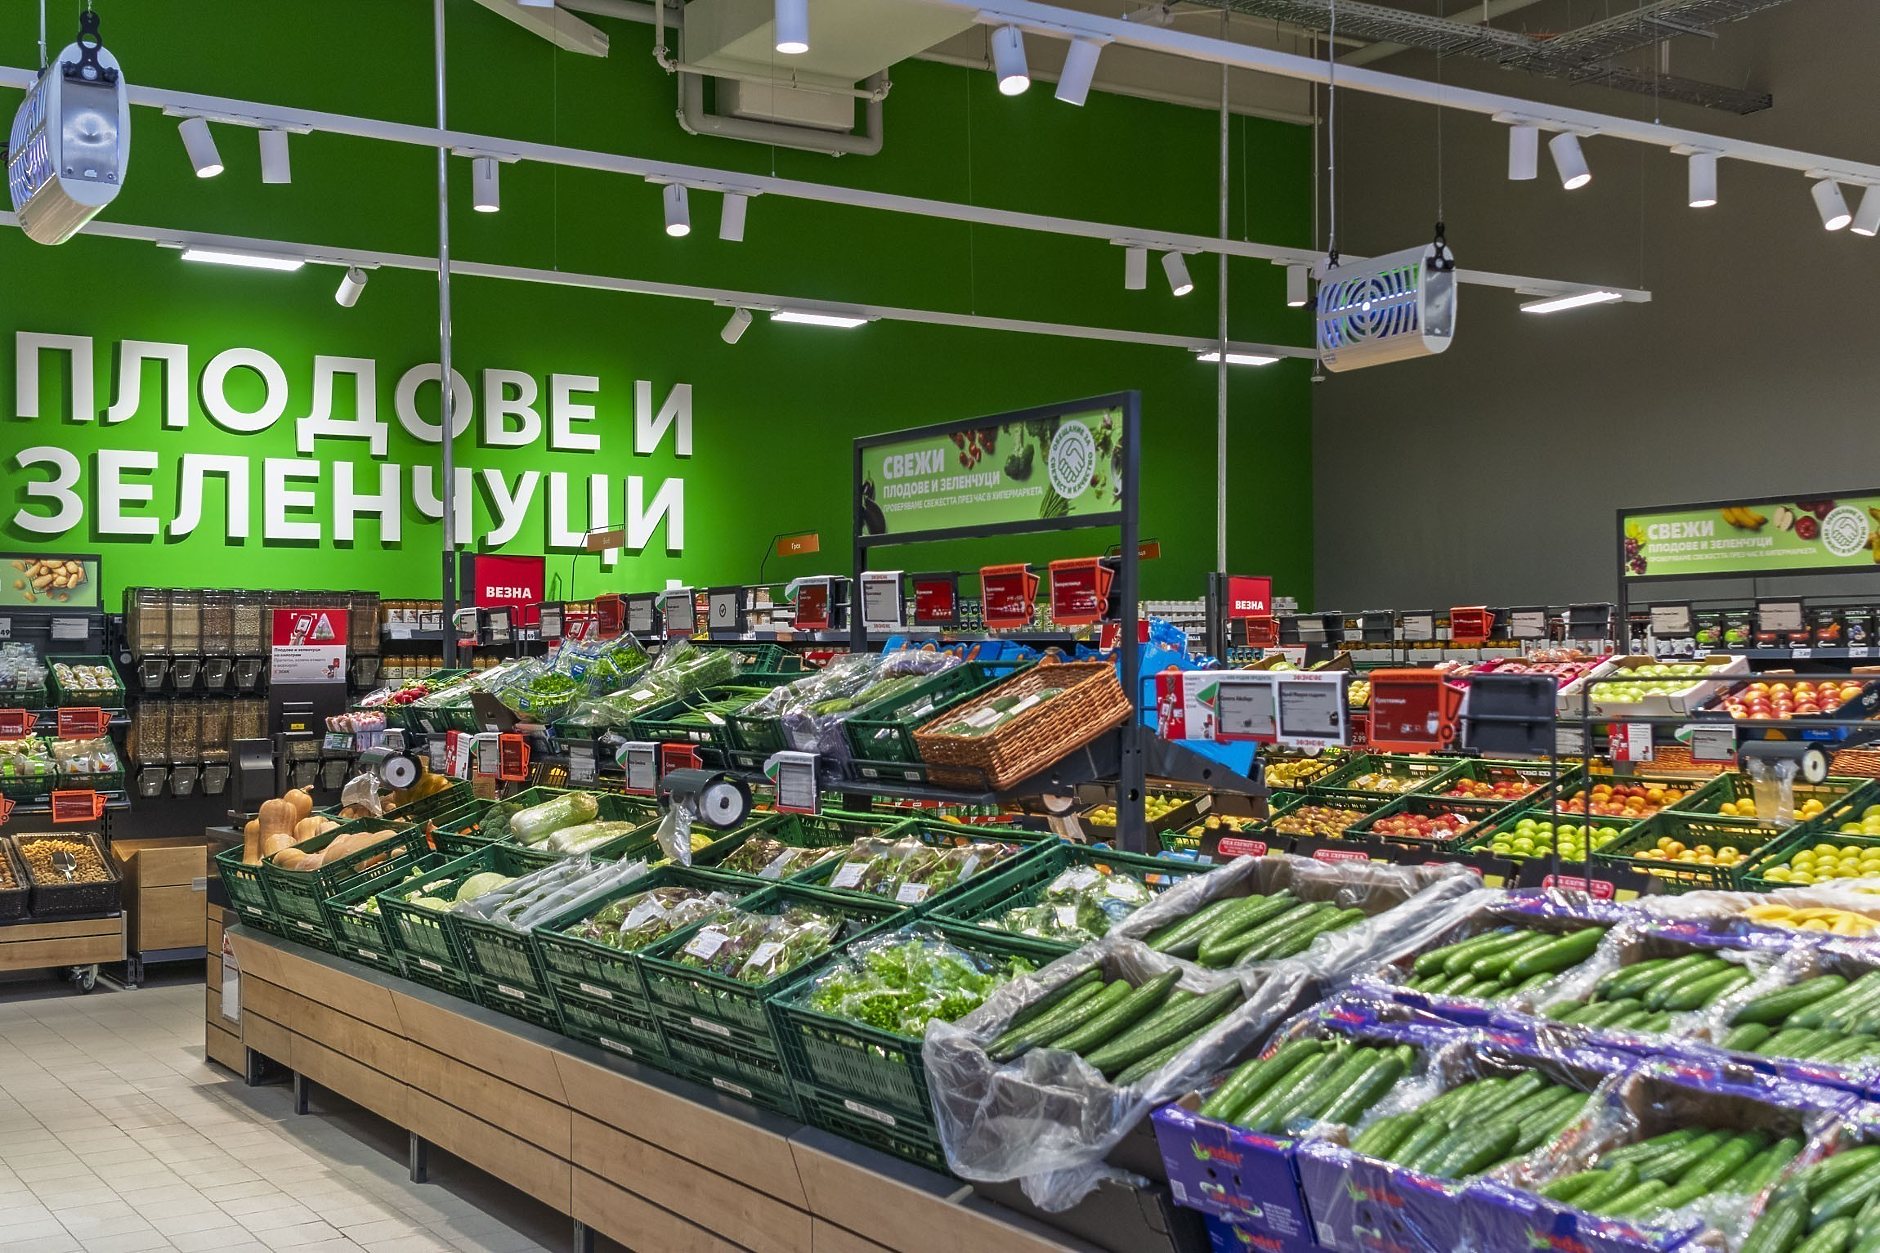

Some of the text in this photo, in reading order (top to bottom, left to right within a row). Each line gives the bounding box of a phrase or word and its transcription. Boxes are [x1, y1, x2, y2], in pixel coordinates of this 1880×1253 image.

[15, 331, 693, 457] ПЛОДОВЕ И
[883, 448, 945, 480] СВЕЖИ
[883, 470, 1000, 499] ПЛОДОВЕ И ЗЕЛЕНЧУЦИ
[12, 446, 685, 565] ЗЕЛЕНЧУЦИ
[1647, 520, 1714, 540] СВЕЖИ
[1647, 536, 1773, 554] ПЛОДОВЕ И ЗЕЛЕНЧУЦИ
[486, 586, 532, 599] ВЕЗНА
[1235, 600, 1264, 610] ВЕЗНА
